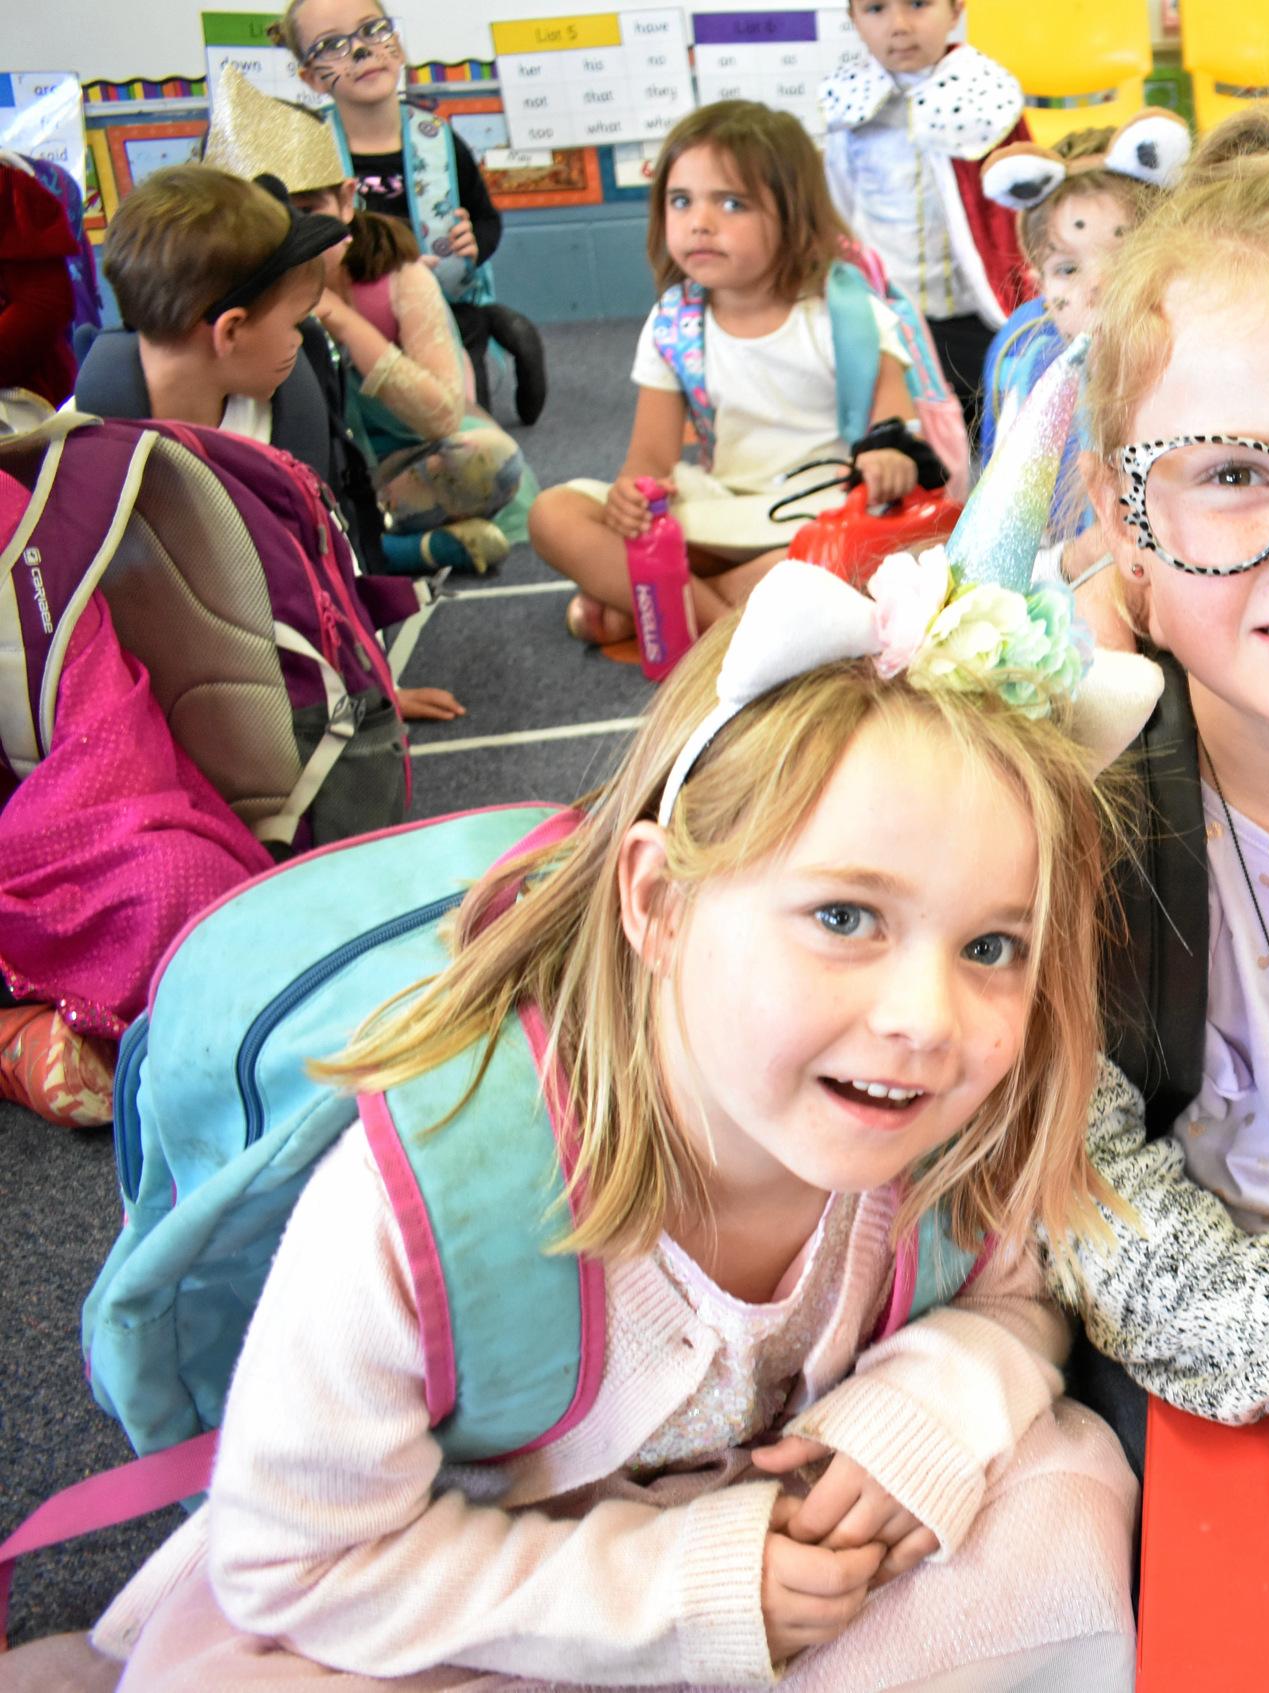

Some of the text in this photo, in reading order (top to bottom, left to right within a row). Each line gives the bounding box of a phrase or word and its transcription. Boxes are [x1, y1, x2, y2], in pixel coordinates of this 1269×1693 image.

[535, 25, 578, 44] List 5
[634, 22, 669, 33] have
[583, 59, 604, 72] his
[648, 55, 666, 66] no
[518, 63, 542, 77] her
[583, 89, 614, 103] that
[645, 84, 678, 101] they
[523, 96, 548, 109] not
[528, 126, 554, 140] too
[587, 120, 622, 134] what
